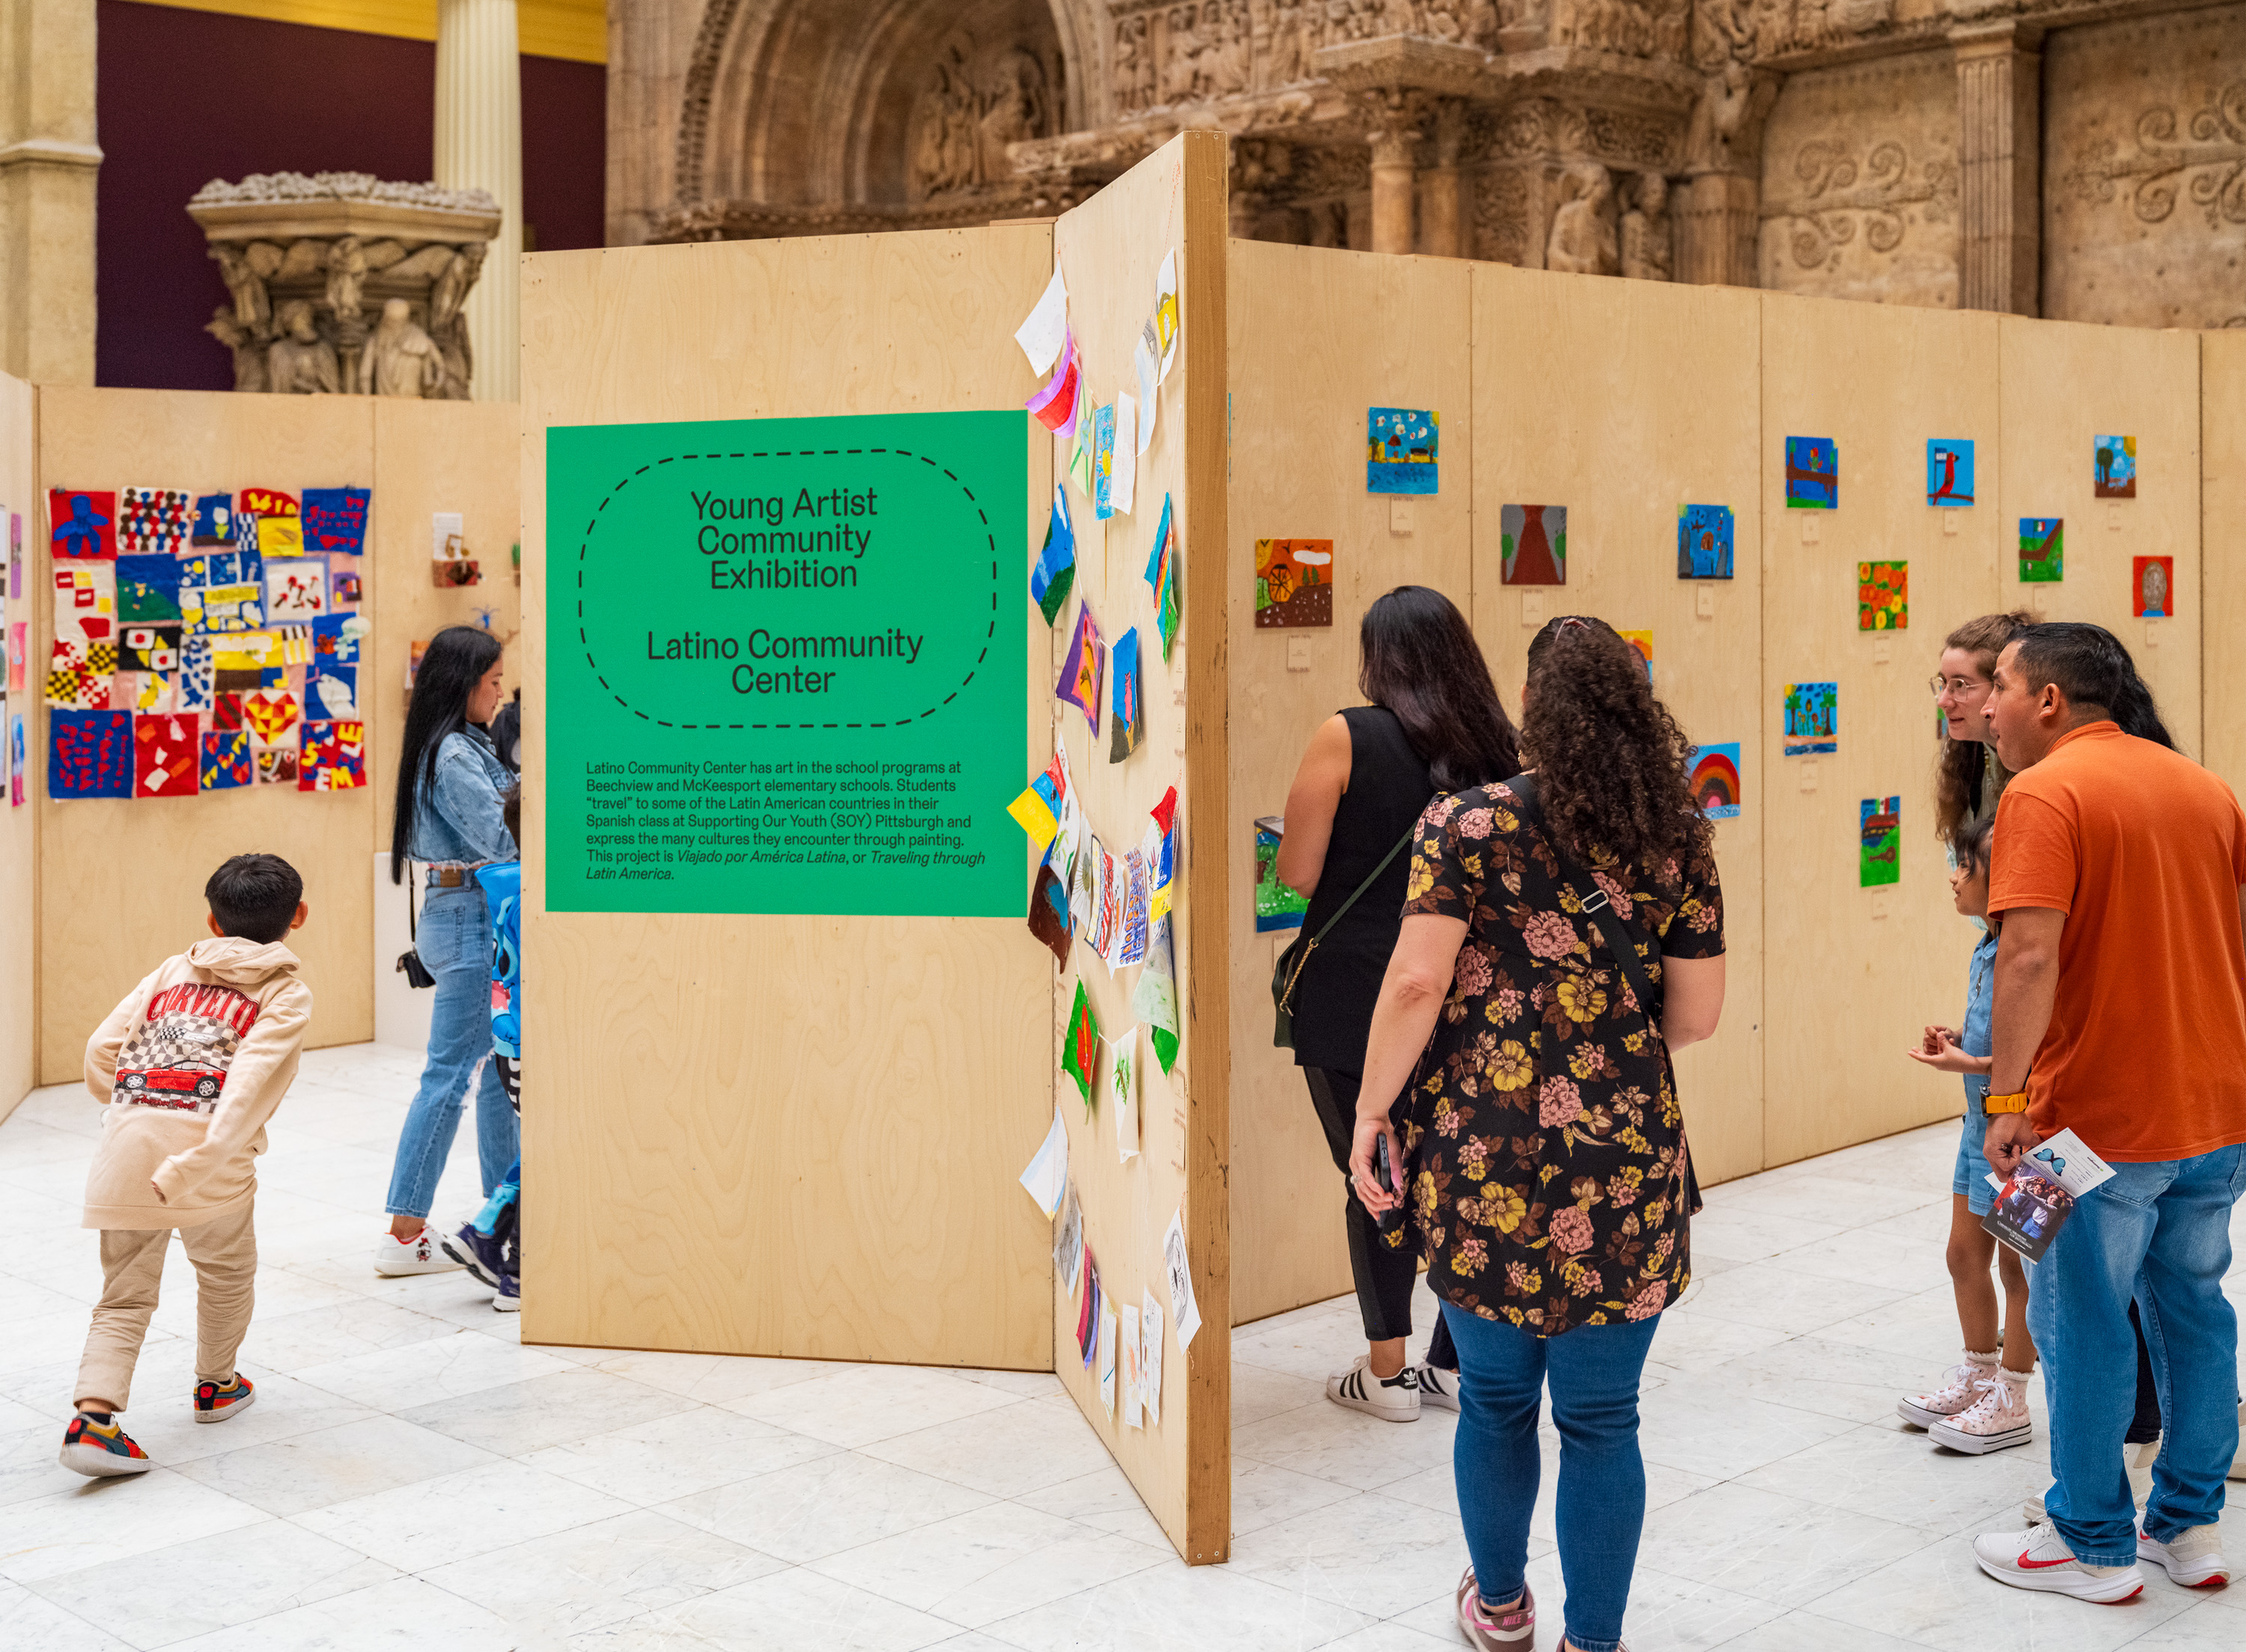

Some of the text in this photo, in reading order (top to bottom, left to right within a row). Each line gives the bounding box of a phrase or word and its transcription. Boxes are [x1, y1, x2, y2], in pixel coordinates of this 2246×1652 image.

[690, 487, 878, 527] Young Artist
[698, 522, 871, 559] Community
[711, 558, 857, 590] Exhibition
[648, 628, 924, 665] Latino Community
[731, 663, 836, 695] Center
[586, 761, 961, 777] Latino Community Center has art in the school programs at
[586, 778, 956, 795] Beechview and McKeesport elementary schools. Students
[636, 797, 649, 809] to
[651, 799, 686, 810] some
[689, 796, 702, 809] of
[705, 796, 726, 809] the
[729, 796, 761, 809] Latin
[764, 796, 826, 810] American
[829, 797, 890, 810] countries
[894, 797, 905, 809] in
[908, 796, 939, 810] their
[586, 812, 971, 832] Spanish class at Supporting Our Youth (SOY) Pittsburgh and
[586, 832, 964, 850] express the many cultures they encounter through painting.
[586, 849, 985, 868] This project is Viajado por América Latina, or Traveling through
[586, 867, 675, 880] Latin America.
[1502, 1614, 1521, 1627] NIKE
